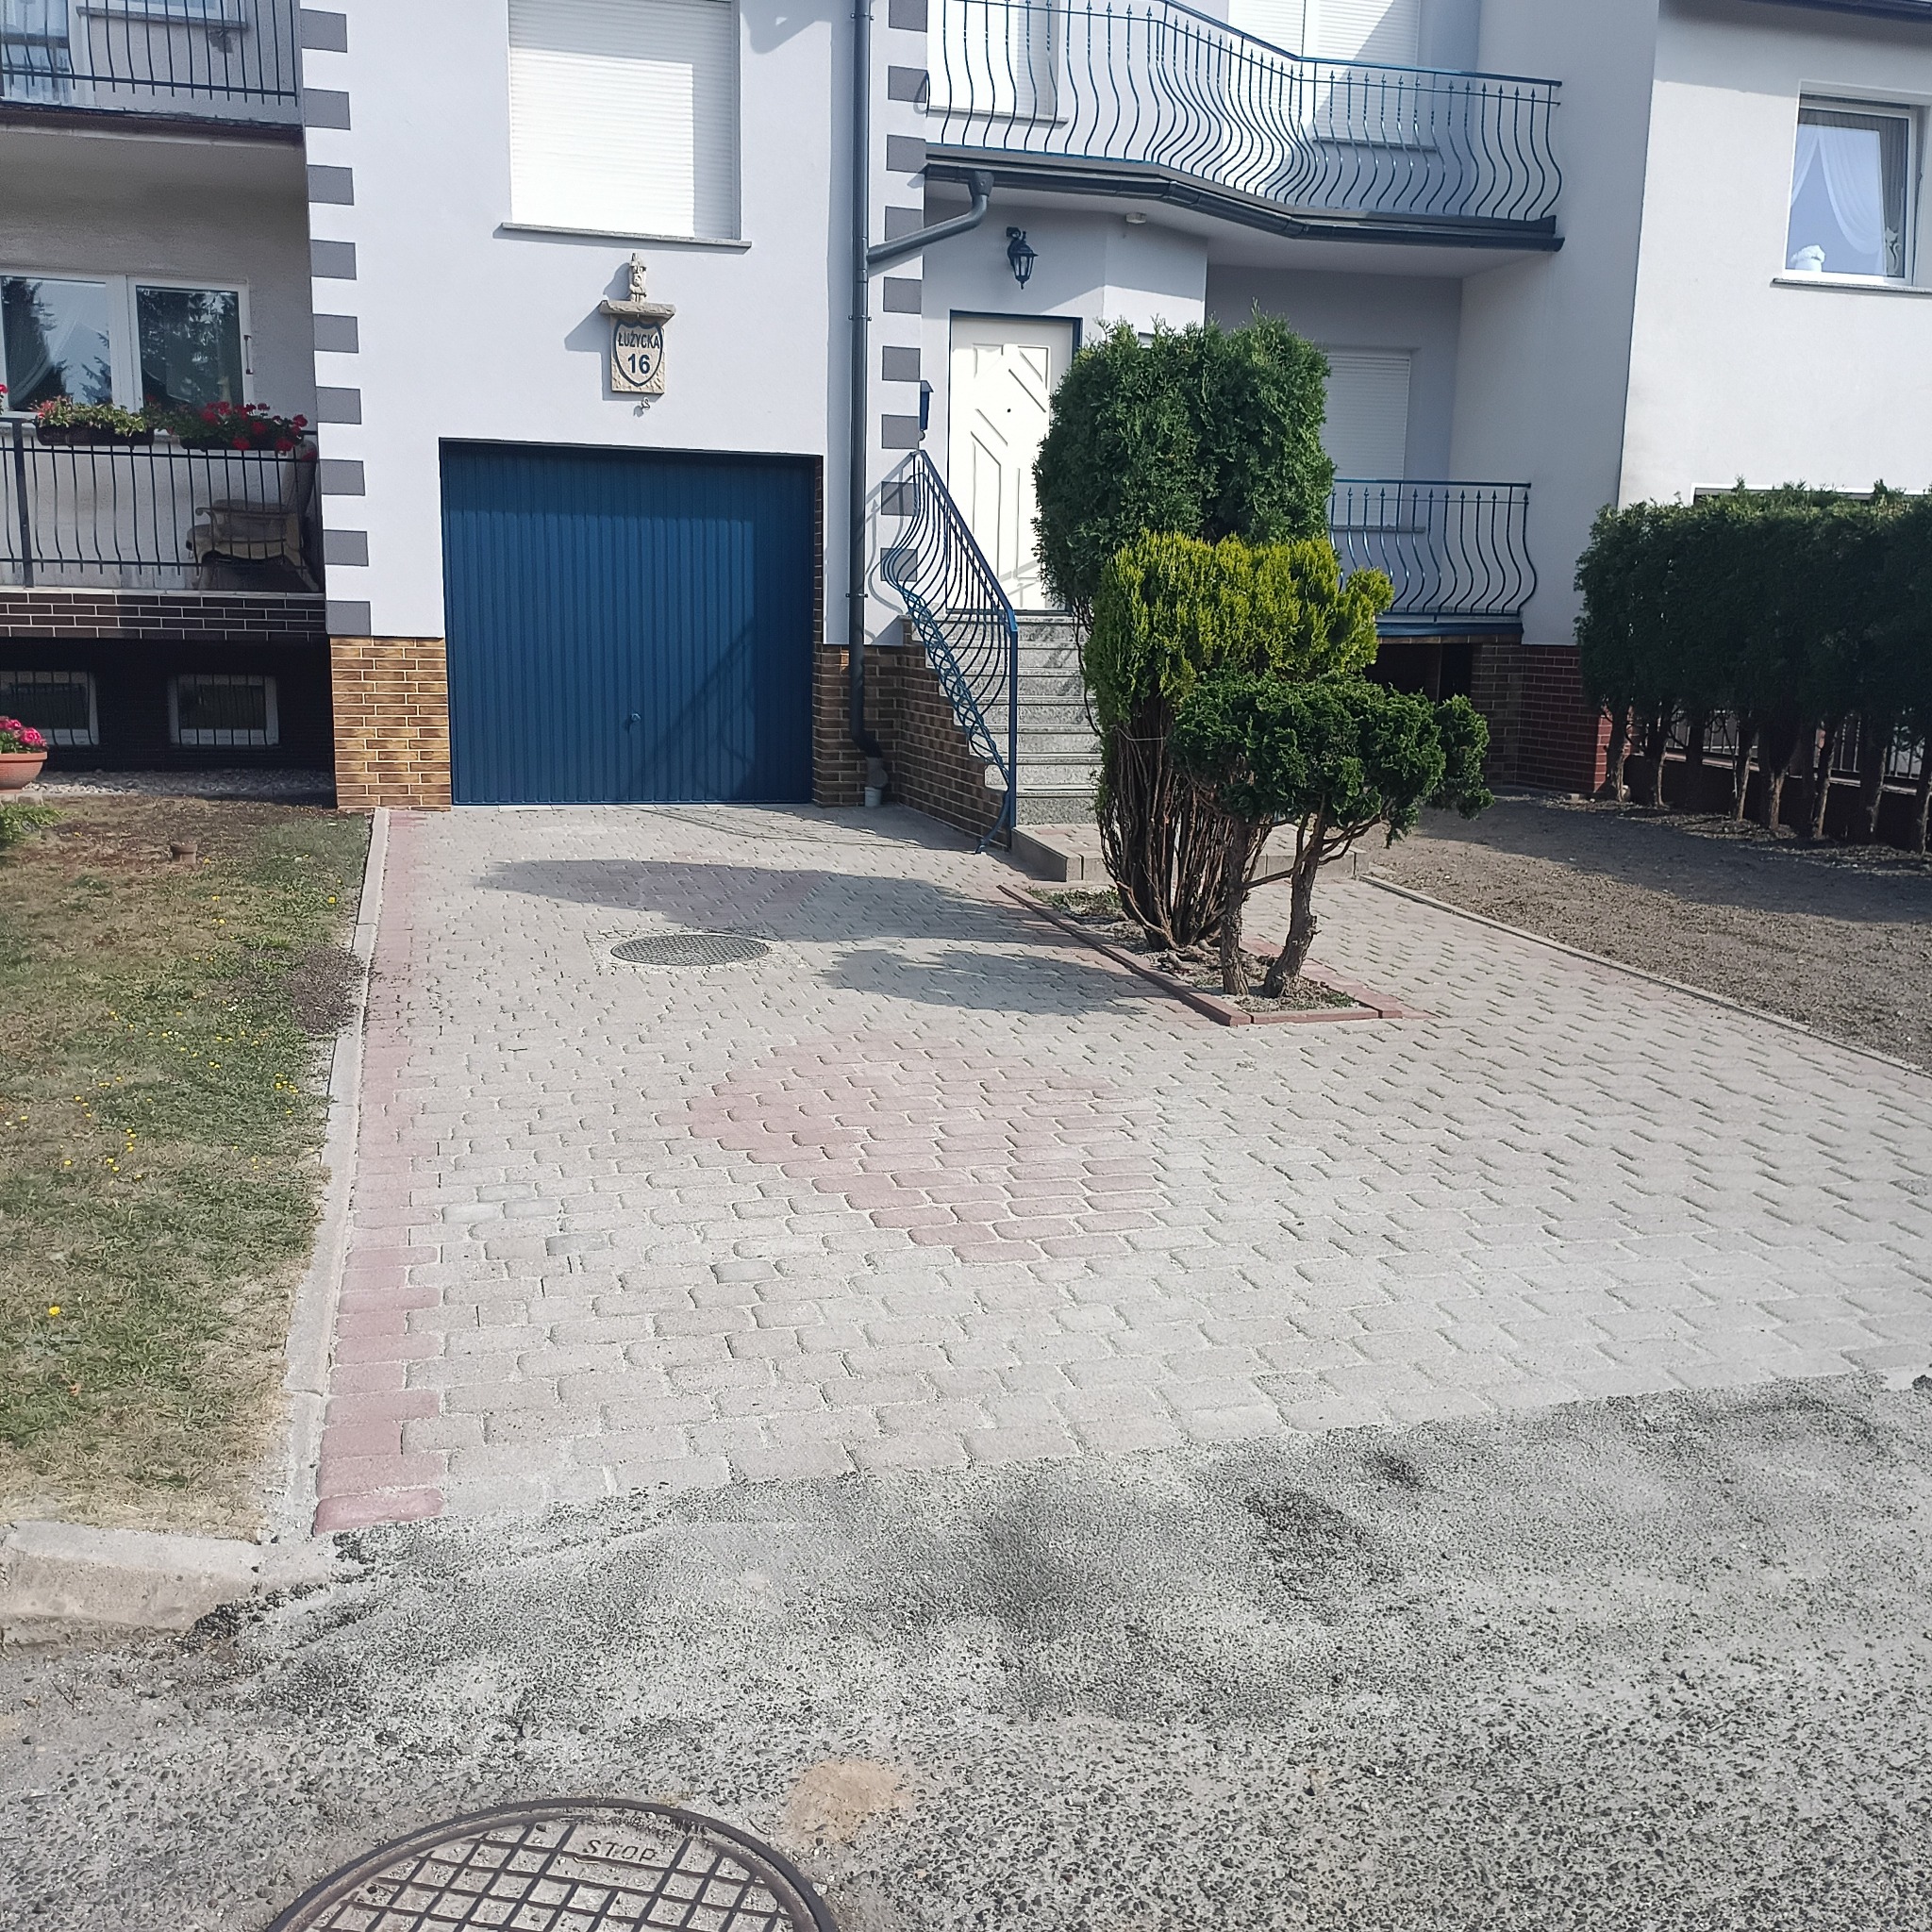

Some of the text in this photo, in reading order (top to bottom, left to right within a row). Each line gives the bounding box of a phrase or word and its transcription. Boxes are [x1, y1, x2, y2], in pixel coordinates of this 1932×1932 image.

[618, 330, 660, 349] ŁUŻYCKA
[627, 353, 651, 375] 16
[583, 1839, 657, 1862] STOP
